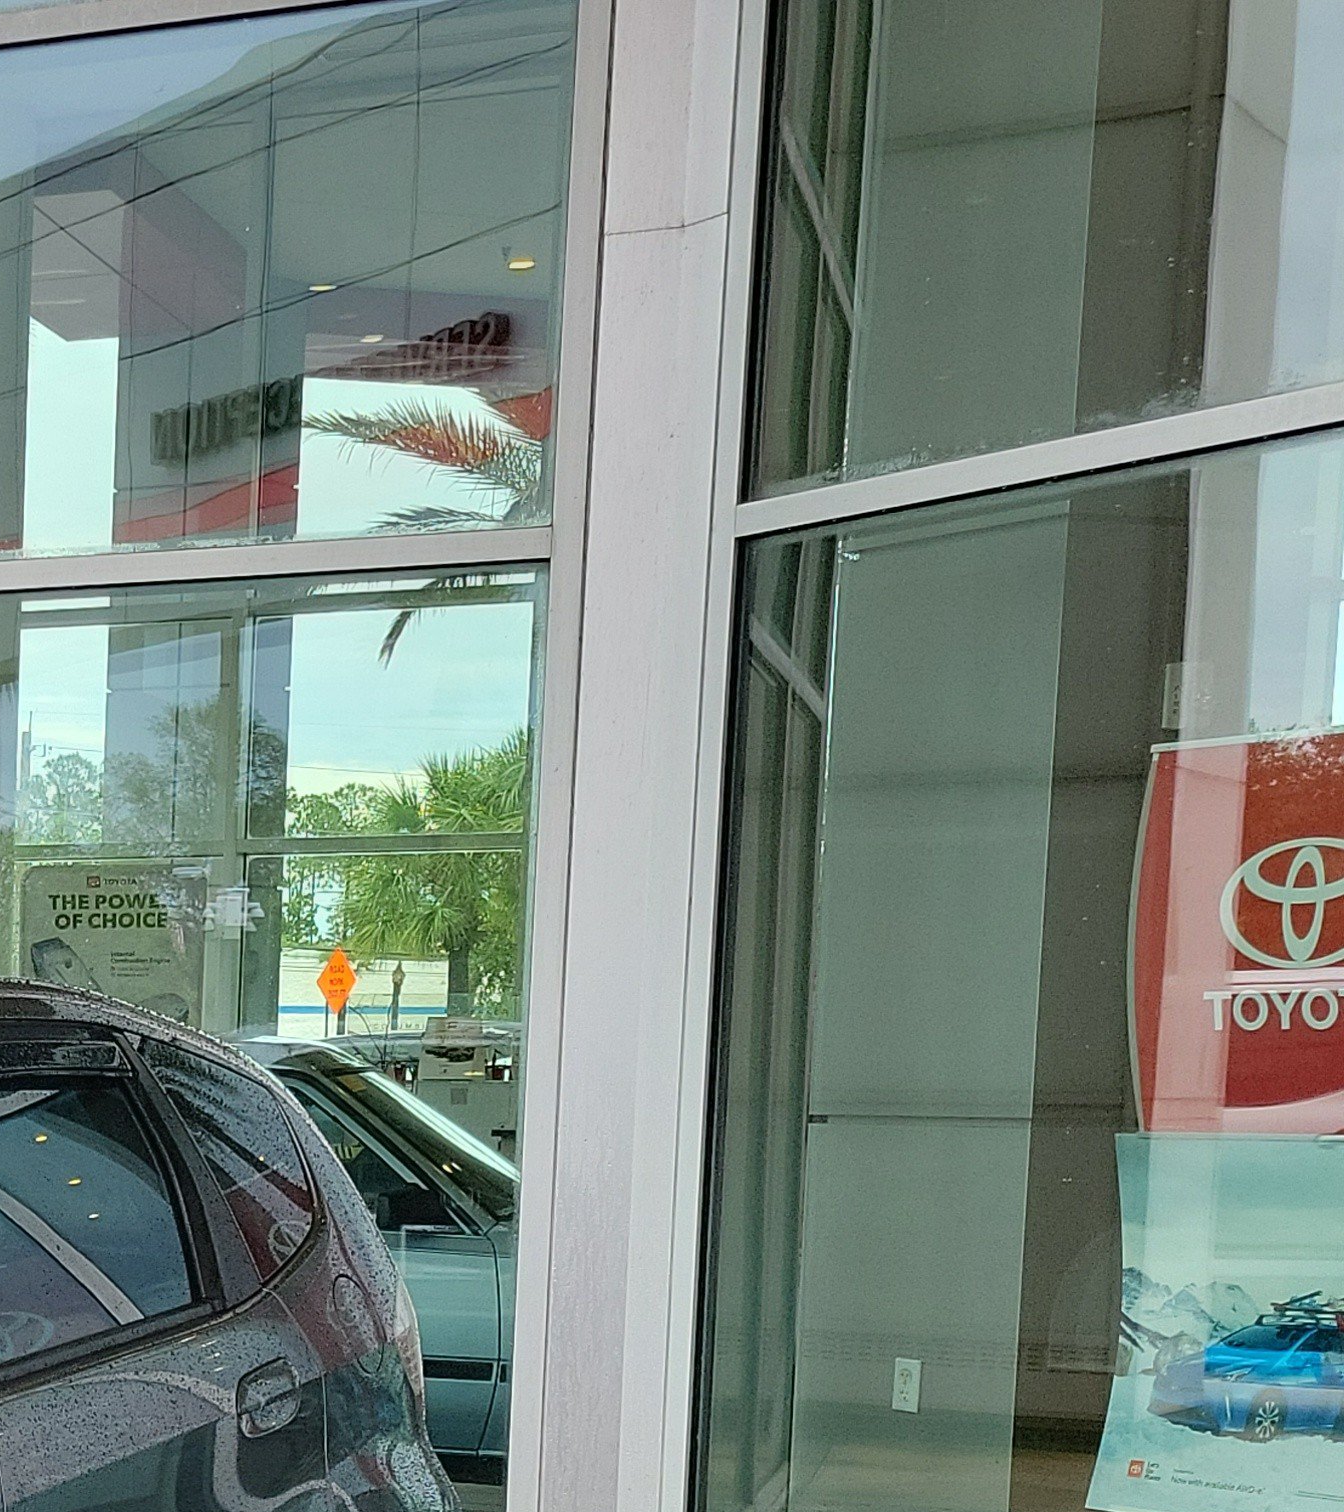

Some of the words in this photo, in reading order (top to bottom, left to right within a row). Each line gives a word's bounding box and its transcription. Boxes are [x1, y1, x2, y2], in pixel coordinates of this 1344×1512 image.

[48, 894, 89, 910] THE
[95, 893, 167, 910] POWE
[55, 913, 83, 930] OF
[88, 912, 168, 929] CHOICE
[1203, 988, 1344, 1031] TOYO
